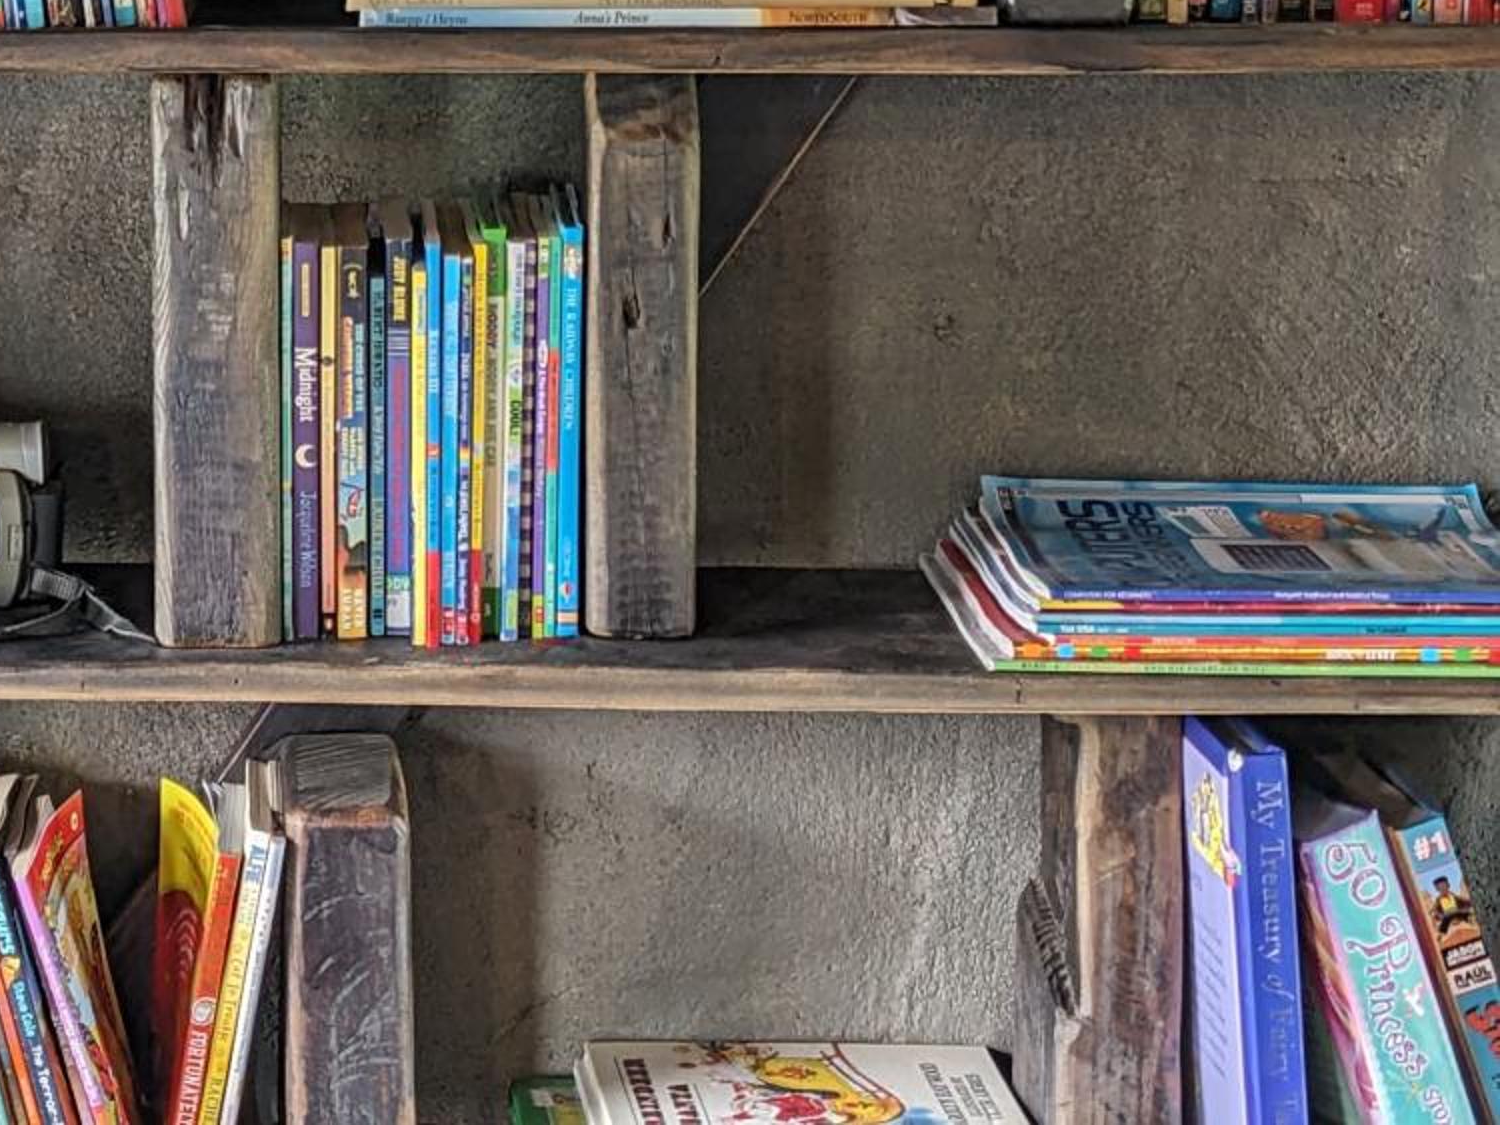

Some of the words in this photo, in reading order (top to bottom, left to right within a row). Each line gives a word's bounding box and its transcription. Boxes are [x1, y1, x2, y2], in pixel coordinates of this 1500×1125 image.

[573, 11, 612, 25] Anna's
[615, 10, 649, 26] Prince
[294, 347, 318, 422] Midnight
[1249, 780, 1282, 829] My
[1325, 840, 1388, 909] 50
[1413, 832, 1449, 861] #1
[1258, 840, 1286, 963] Treasury
[1262, 975, 1295, 1000] of
[1347, 916, 1427, 1078] Princess
[20, 1012, 36, 1038] Cole
[29, 1042, 46, 1069] The
